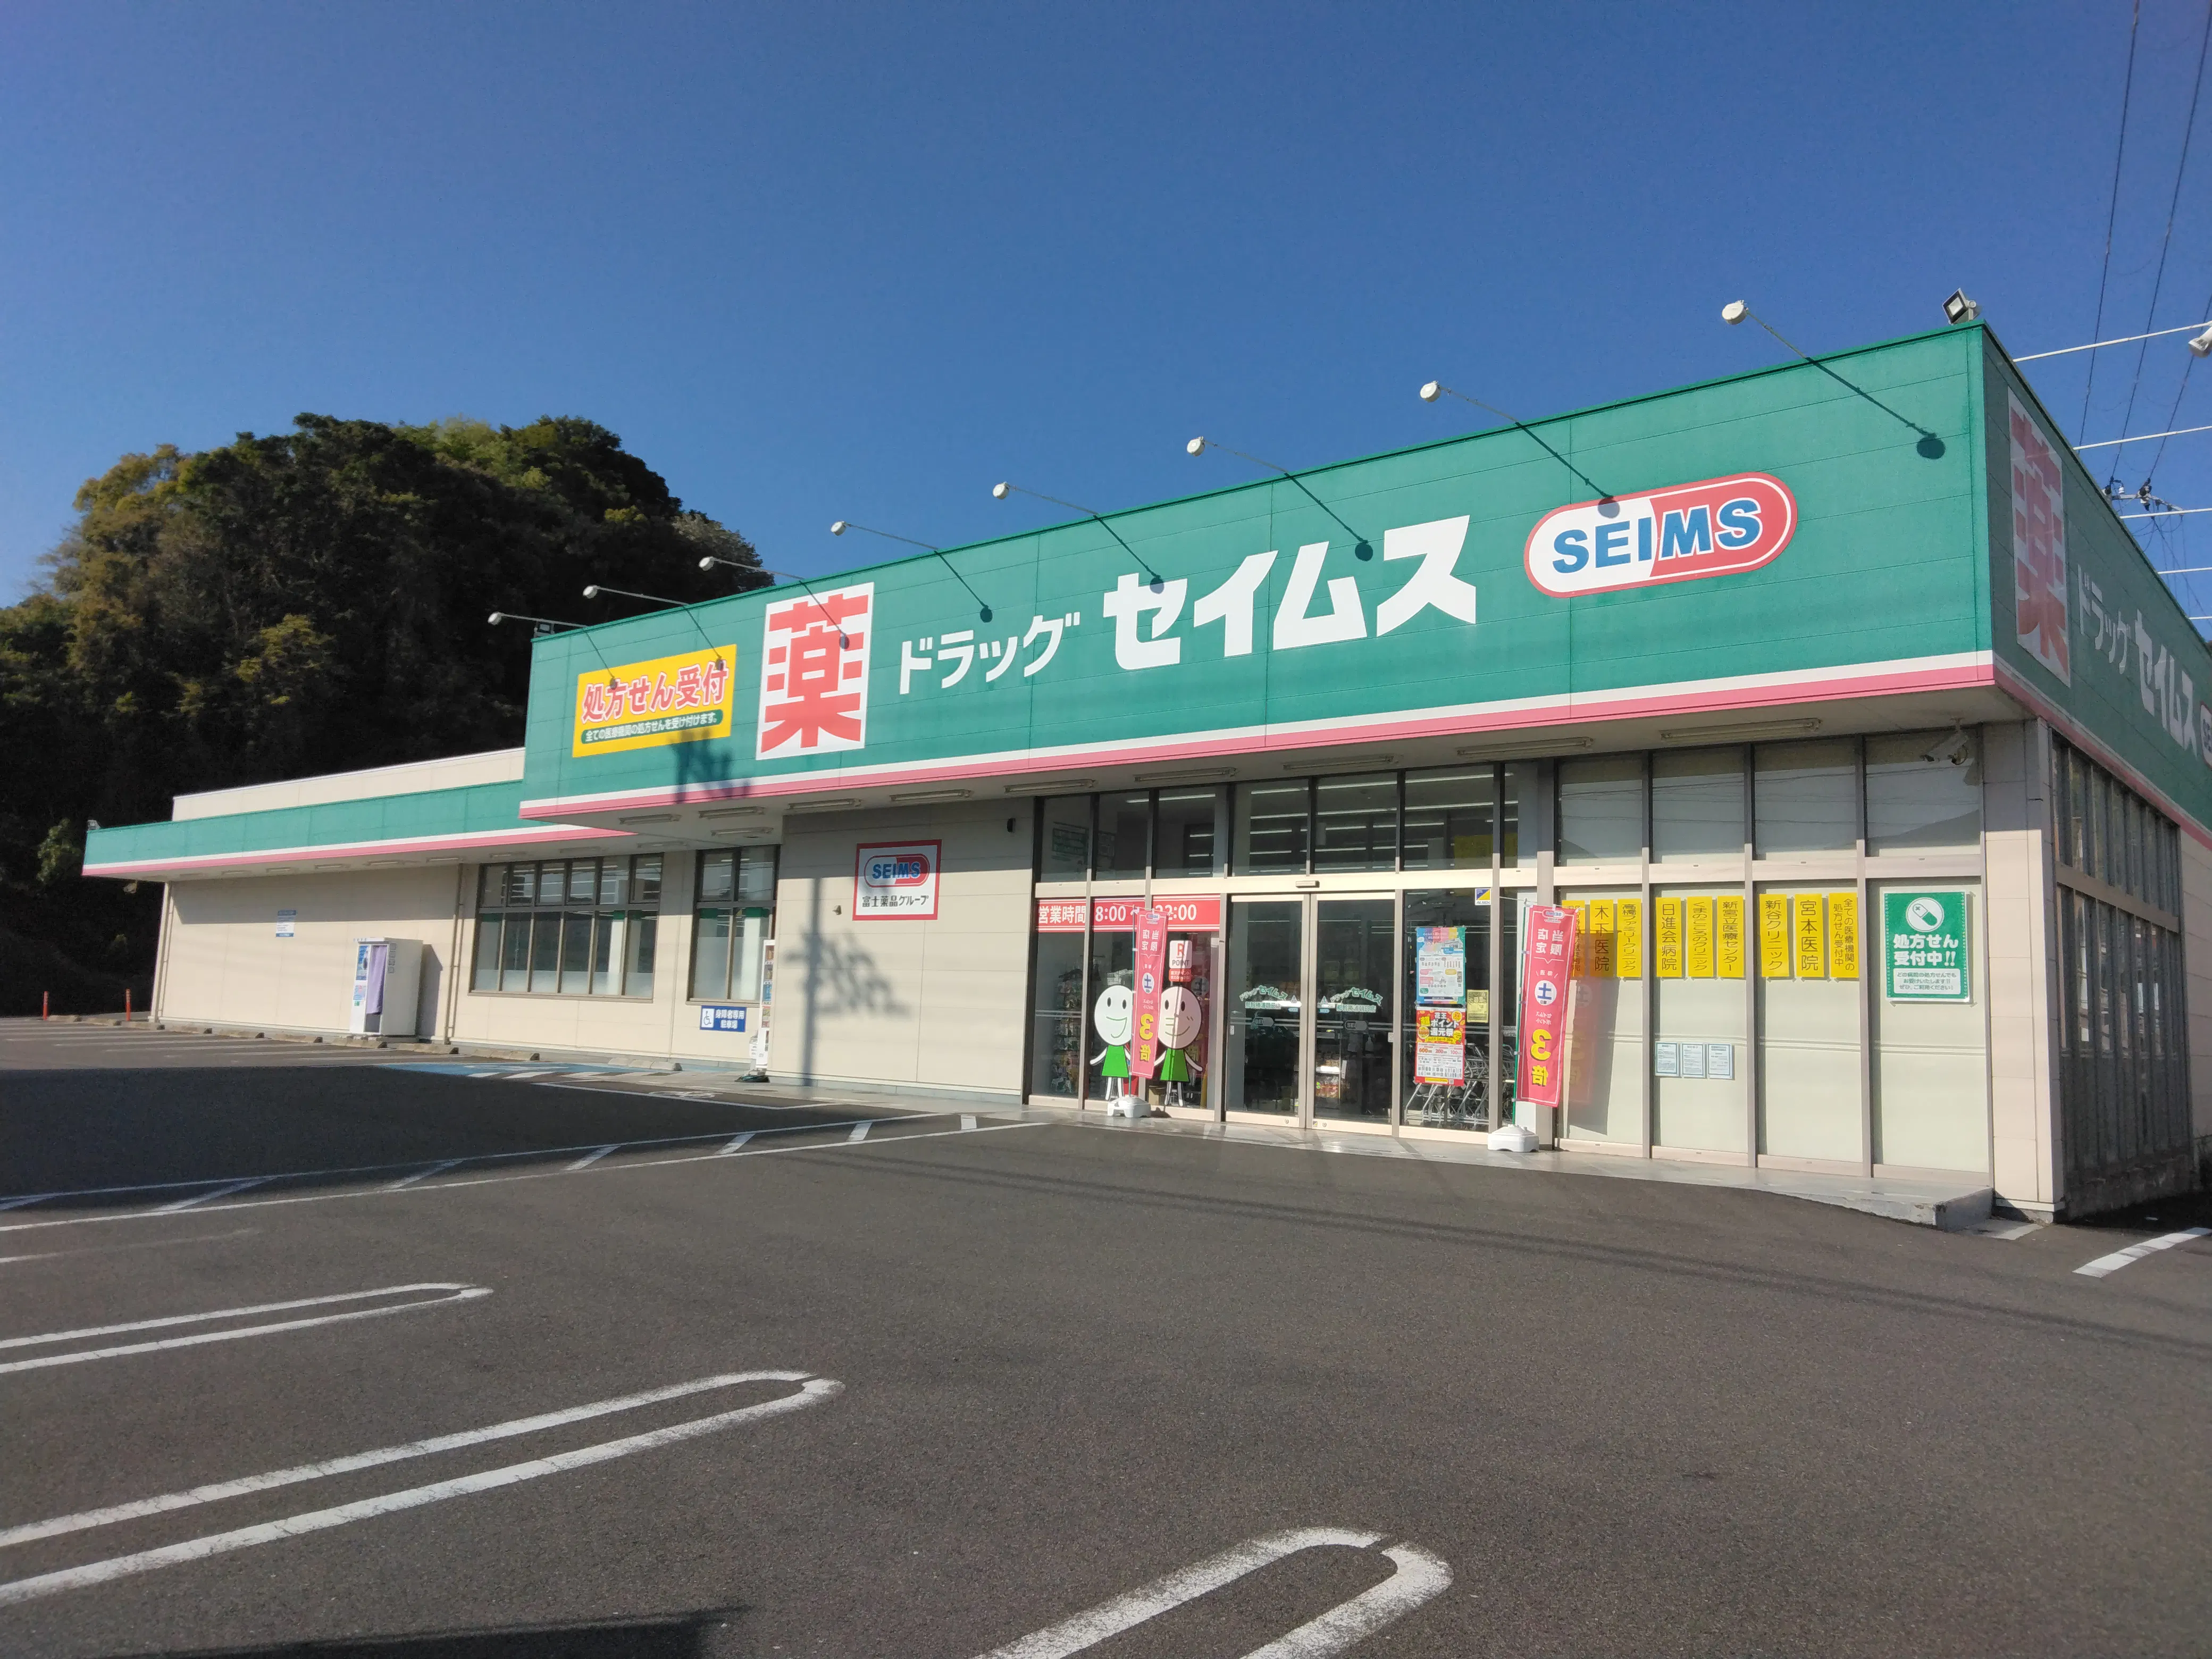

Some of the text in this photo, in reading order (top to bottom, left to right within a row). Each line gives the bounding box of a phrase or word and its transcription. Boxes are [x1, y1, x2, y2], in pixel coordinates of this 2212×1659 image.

[1552, 497, 1763, 574] SEIMS
[2010, 405, 2068, 676] 薬
[899, 515, 1476, 695] ドラッグ セイムス
[581, 659, 729, 724] 処方せん受付
[761, 593, 869, 753] 薬
[2077, 564, 2198, 760] ドラッグ セイムス
[862, 895, 929, 907] 富士薬品グループ
[872, 861, 921, 879] SEIMS
[1038, 905, 1086, 924] 営業時間
[1095, 906, 1126, 922] 8:00
[1594, 905, 1610, 971] 木下医院
[1661, 903, 1677, 971] 日進会病院
[1765, 900, 1782, 970] 新谷クリニック
[1800, 899, 1819, 971] 宮本医院
[1833, 903, 1844, 967] 処方せん受付中
[1844, 898, 1855, 971] 全ての医療機関の
[1893, 933, 1959, 949] 処方せん
[1430, 1018, 1460, 1028] ポイント
